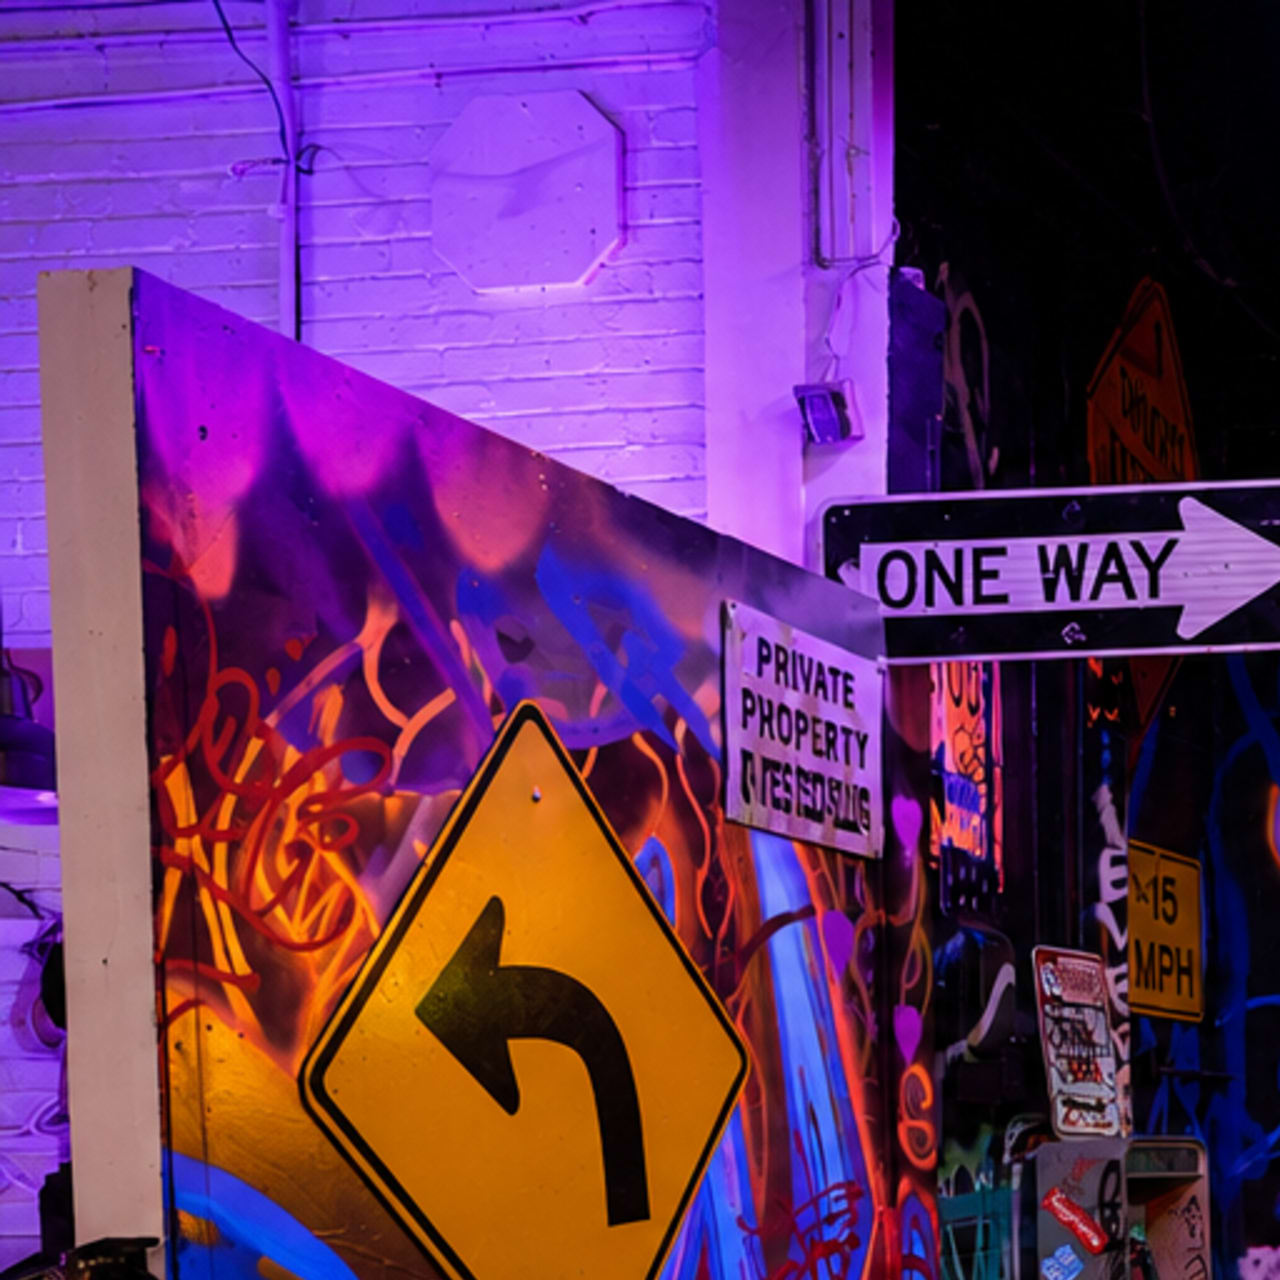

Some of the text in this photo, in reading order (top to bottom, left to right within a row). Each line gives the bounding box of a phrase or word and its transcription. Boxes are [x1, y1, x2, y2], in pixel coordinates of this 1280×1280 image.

[876, 537, 1180, 609] ONE WAY
[757, 636, 855, 710] PRIVATE
[1153, 874, 1178, 925] 15
[1134, 938, 1194, 998] MPH
